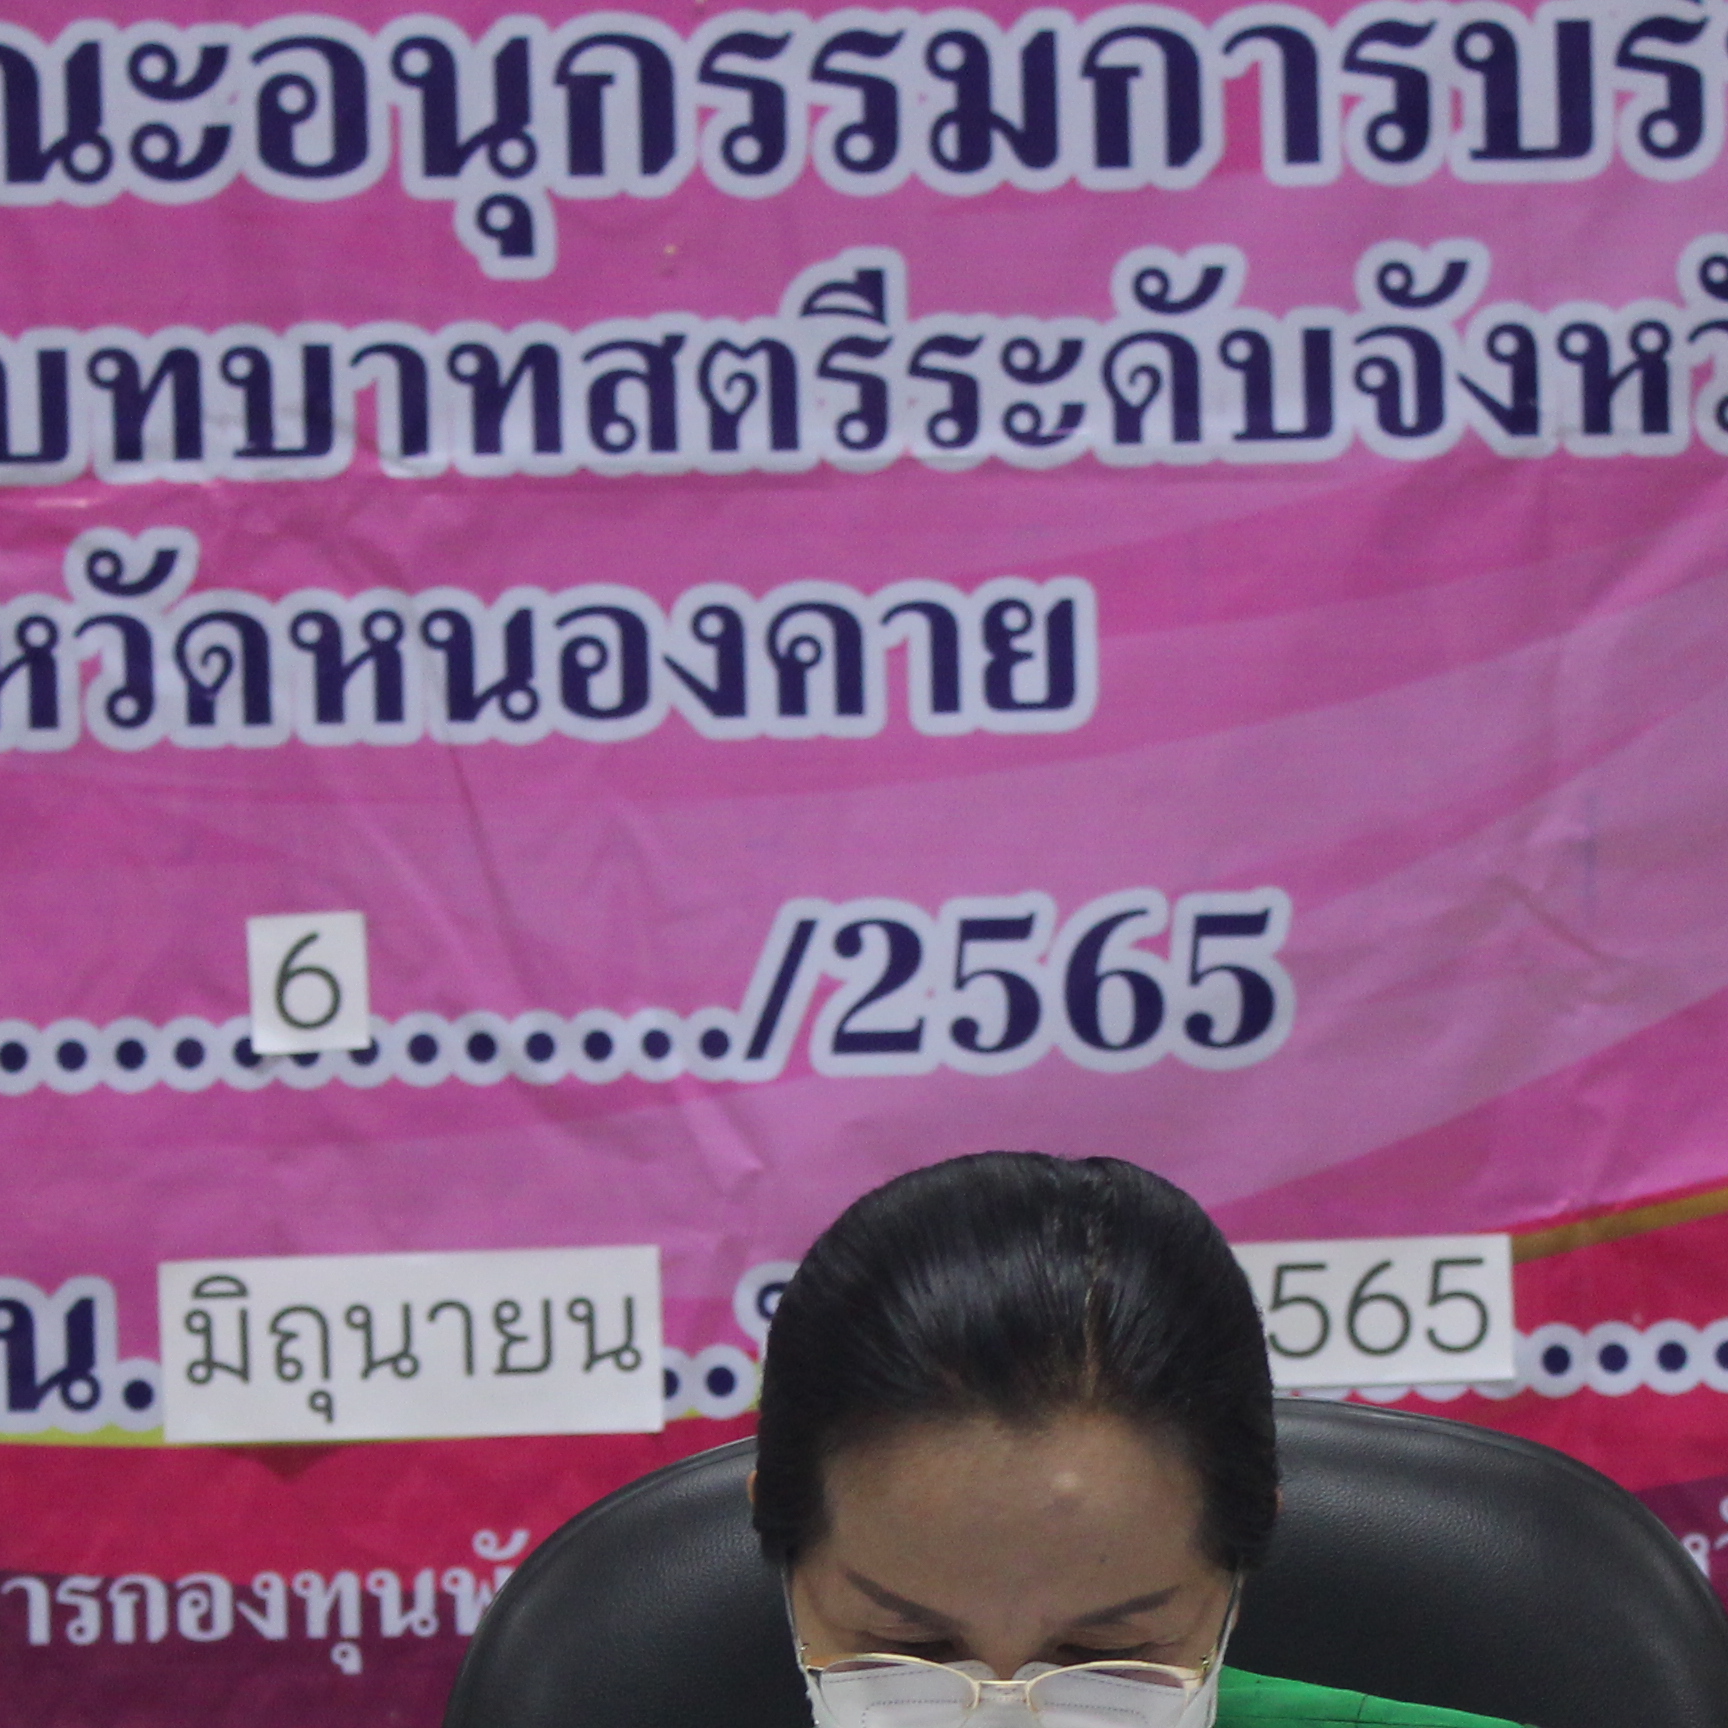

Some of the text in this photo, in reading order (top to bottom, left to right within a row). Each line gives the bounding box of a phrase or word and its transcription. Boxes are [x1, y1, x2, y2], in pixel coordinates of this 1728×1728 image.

[275, 931, 342, 1030] 6
[183, 1274, 642, 1424] มิถุนายน
